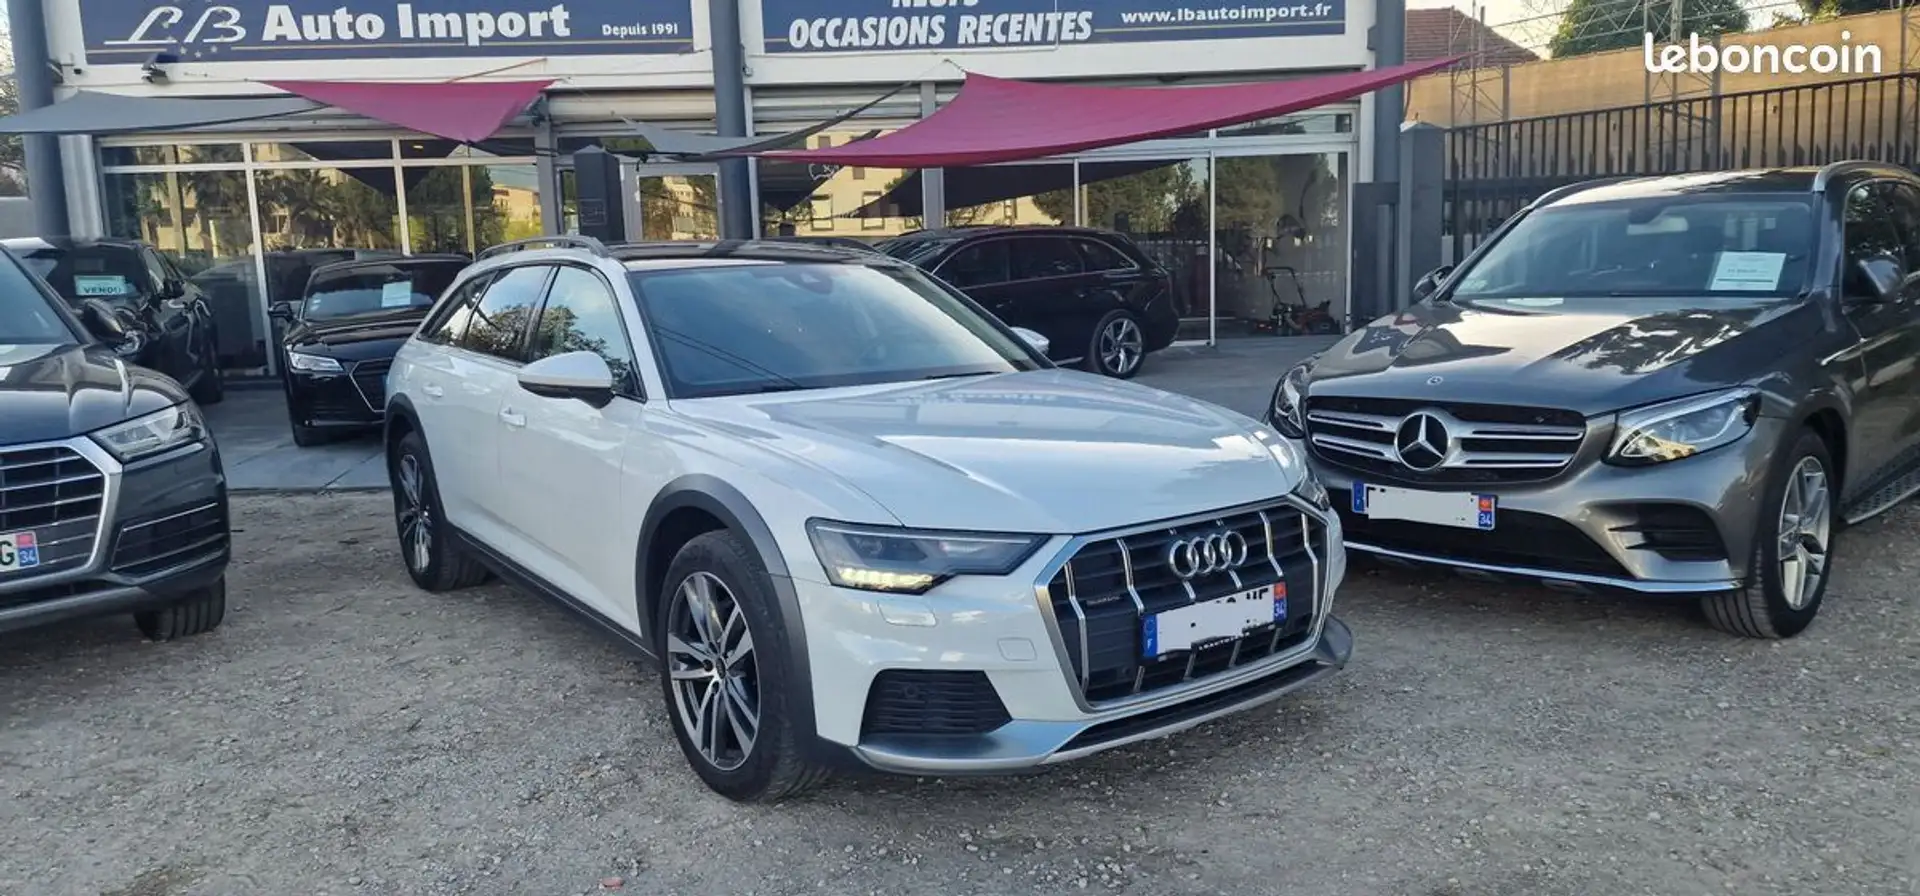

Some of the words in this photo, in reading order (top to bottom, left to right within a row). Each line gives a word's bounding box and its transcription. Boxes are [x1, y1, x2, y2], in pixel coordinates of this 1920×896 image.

[1121, 3, 1332, 23] www.lbautoimport.fr
[104, 6, 246, 44] LB
[262, 5, 385, 41] Auto
[397, 3, 571, 46] Import
[602, 23, 647, 38] Depuis
[651, 23, 678, 36] 1991
[789, 14, 946, 48] OCCASIONS
[957, 11, 1093, 45] RECENTES
[1480, 513, 1491, 525] 34
[20, 550, 36, 563] 34
[1275, 602, 1285, 617] 34
